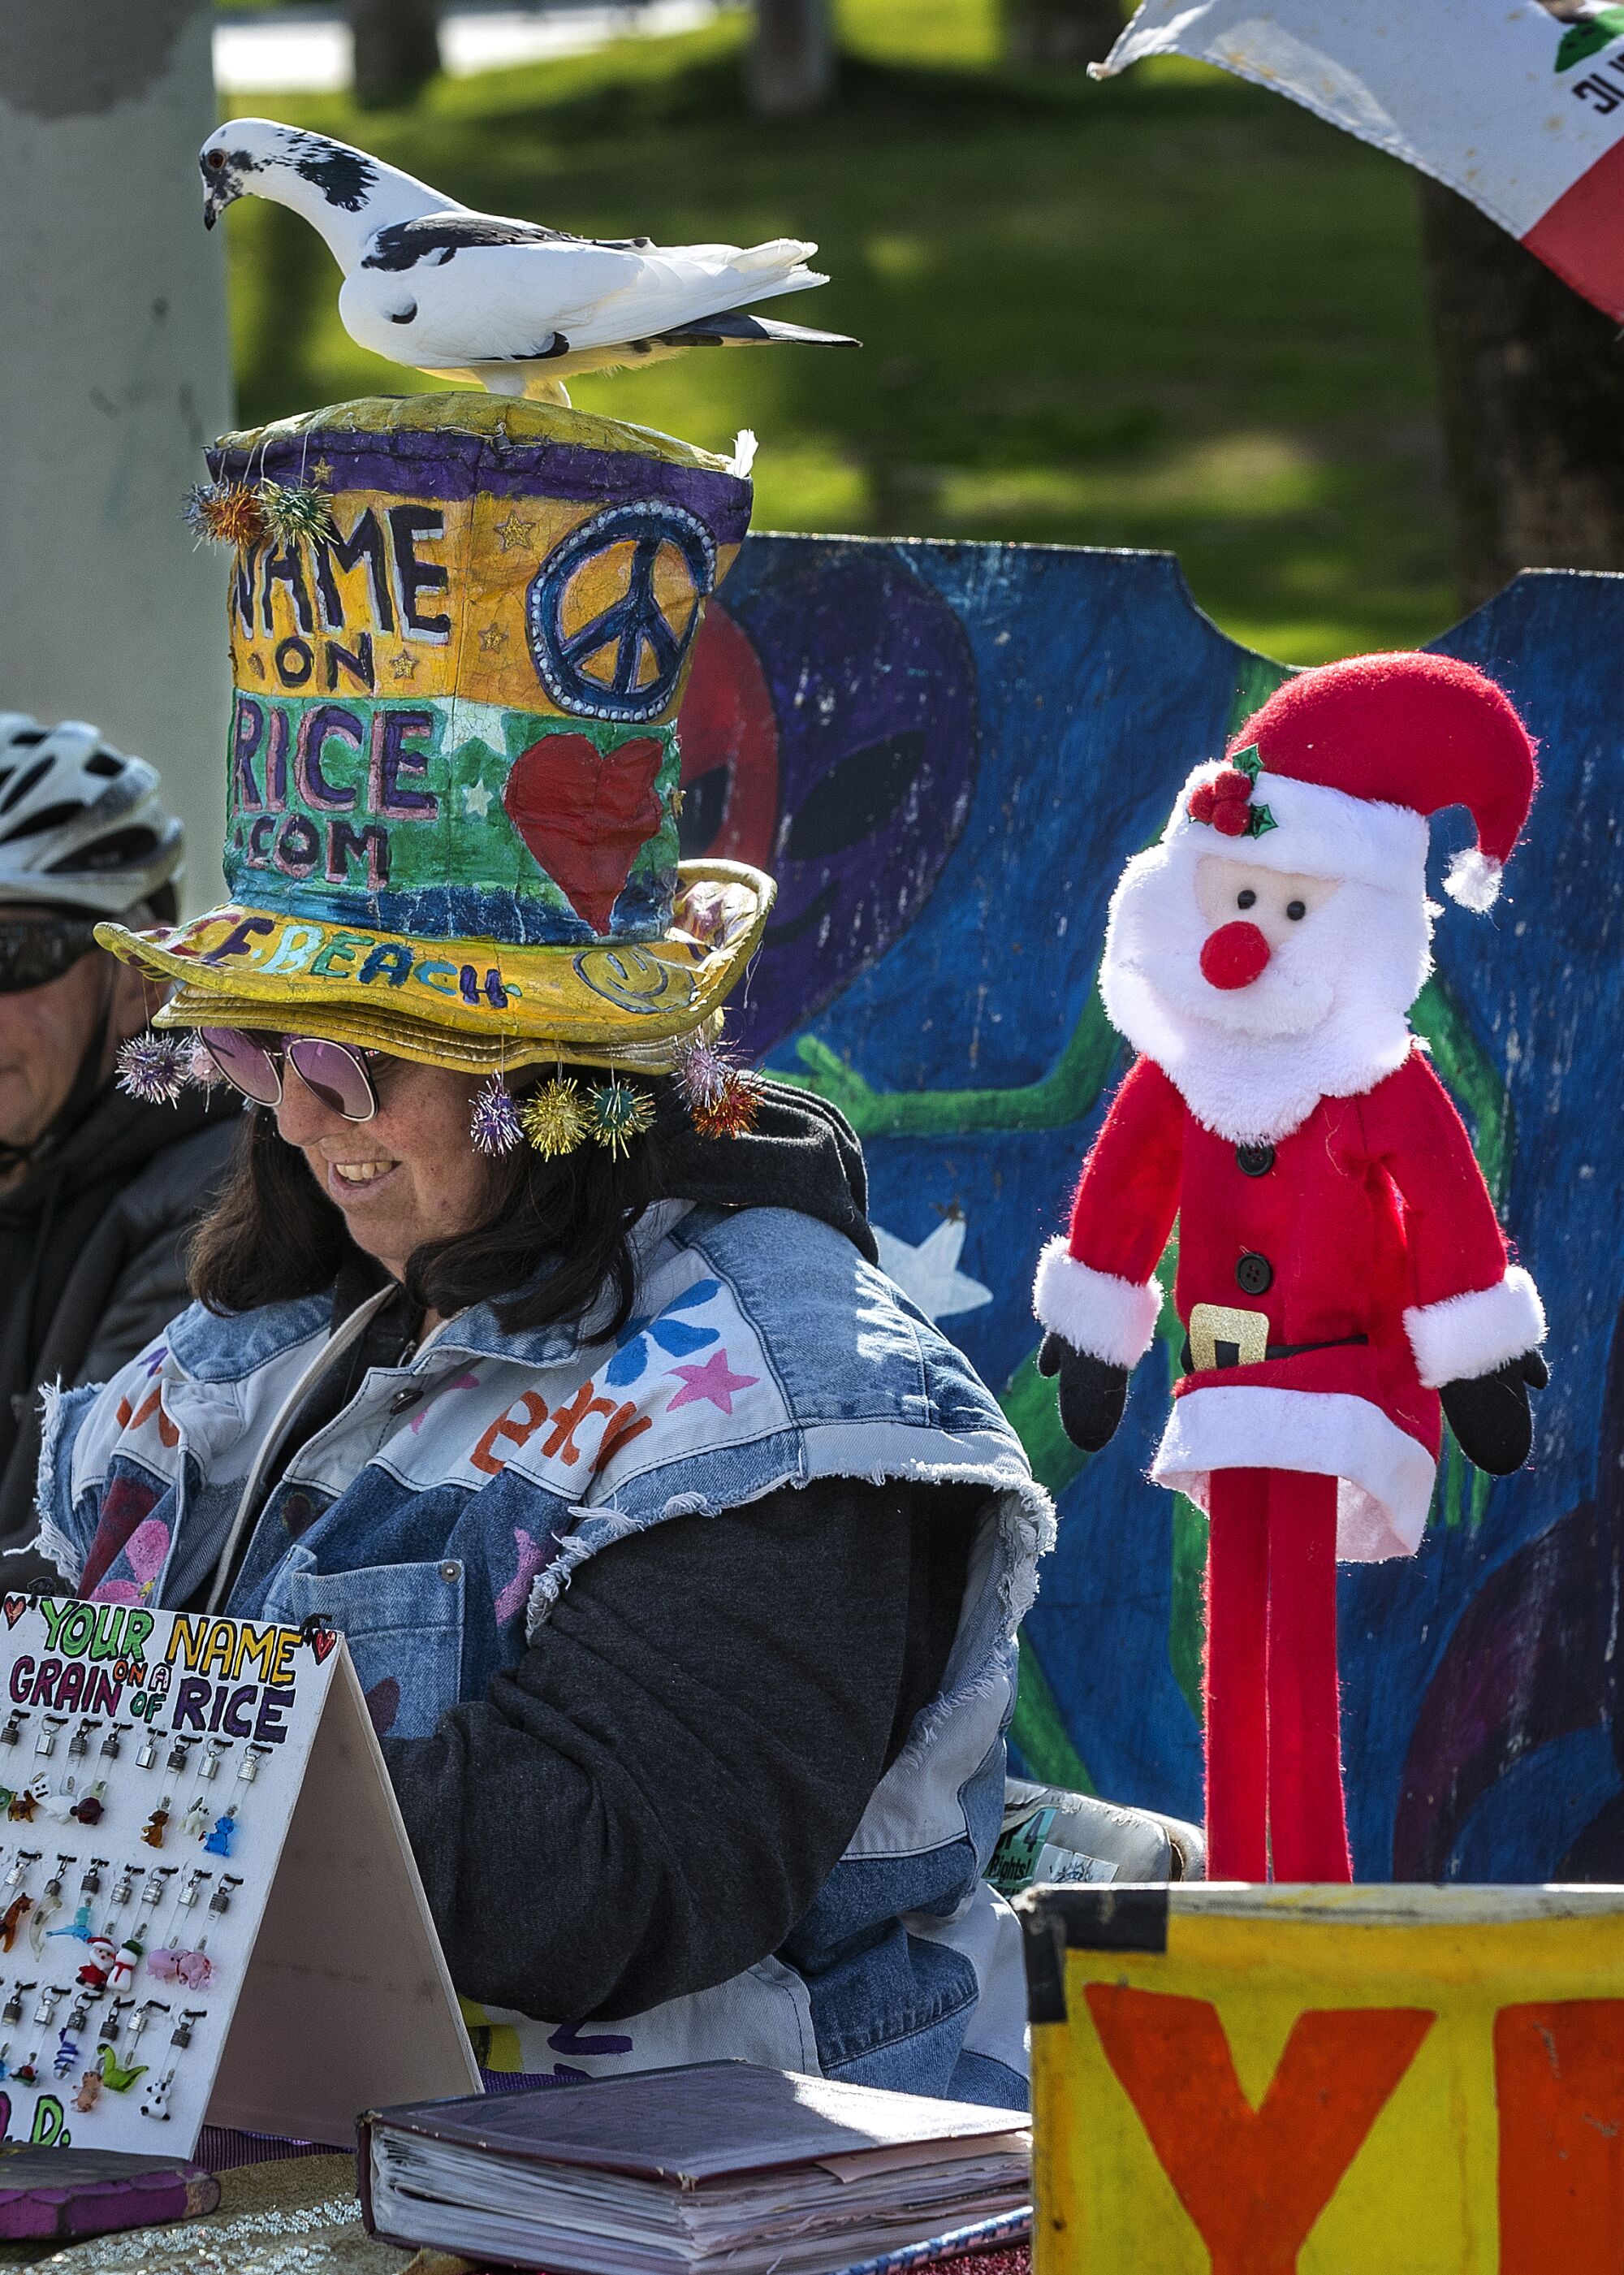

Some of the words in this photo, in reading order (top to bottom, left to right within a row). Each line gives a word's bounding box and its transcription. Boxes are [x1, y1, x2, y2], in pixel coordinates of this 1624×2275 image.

[274, 633, 377, 695] ON
[232, 699, 439, 820] RICE
[39, 1598, 155, 1662] YOUR
[165, 1614, 306, 1687] NAME
[113, 1659, 148, 1688] ON
[150, 1662, 172, 1693] A
[9, 1655, 123, 1717] GRAIN
[130, 1691, 167, 1724] OF
[171, 1676, 296, 1745] RICE
